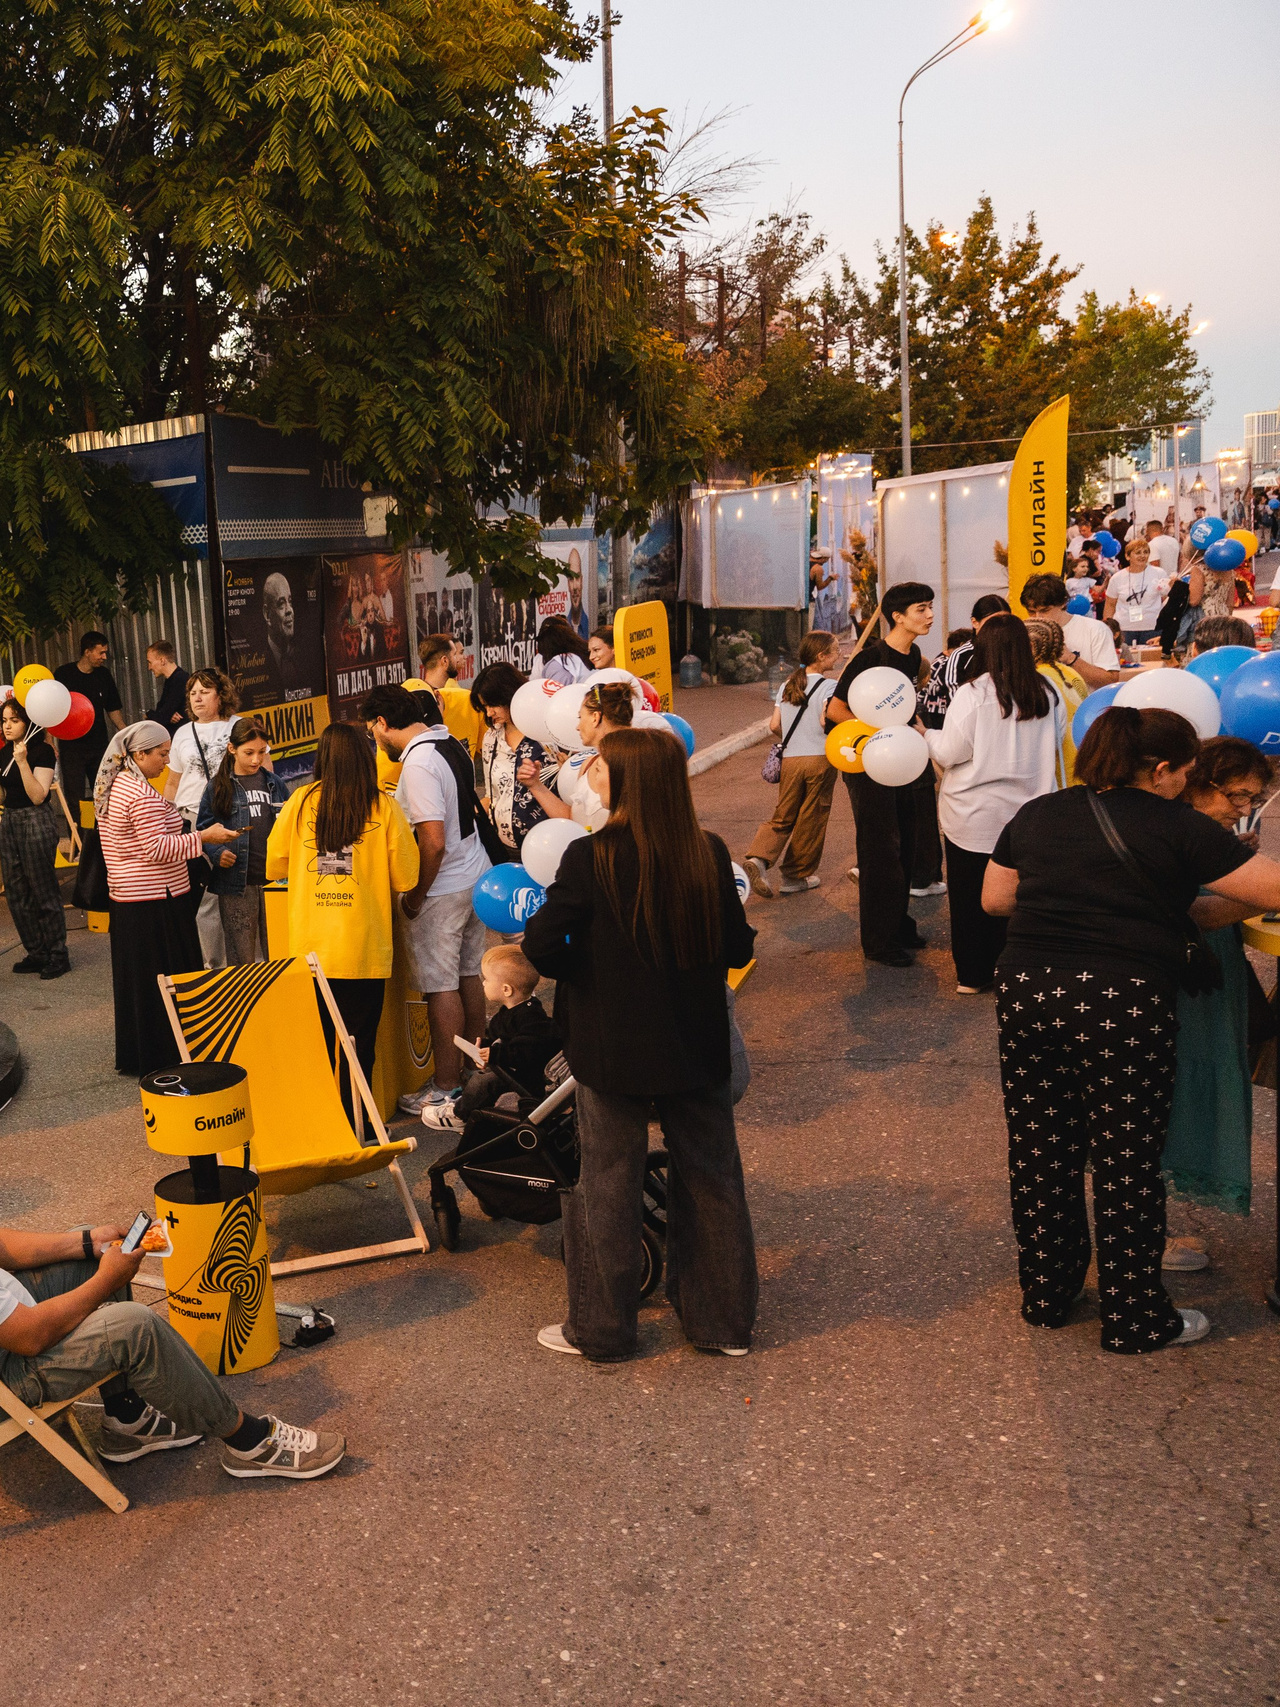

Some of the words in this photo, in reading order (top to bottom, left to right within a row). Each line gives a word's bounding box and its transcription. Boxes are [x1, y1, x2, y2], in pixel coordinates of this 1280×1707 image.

[1029, 460, 1046, 566] билайн
[226, 569, 233, 587] 2
[234, 577, 254, 586] НОЯБРЯ
[227, 588, 240, 597] ТЕАТР
[240, 587, 255, 596] ЮНОГО
[228, 598, 247, 607] ЗРИТЕЛЯ
[538, 602, 566, 615] СИДОРОВ
[228, 608, 240, 617] 19:00
[629, 627, 654, 643] активности
[630, 644, 657, 663] бренд-зоны
[23, 677, 45, 685] била
[337, 673, 350, 697] НИ
[376, 665, 387, 686] НИ
[387, 661, 407, 684] ЗЯТЬ
[249, 804, 262, 818] NY
[315, 892, 354, 900] человек
[194, 1107, 246, 1132] билайн
